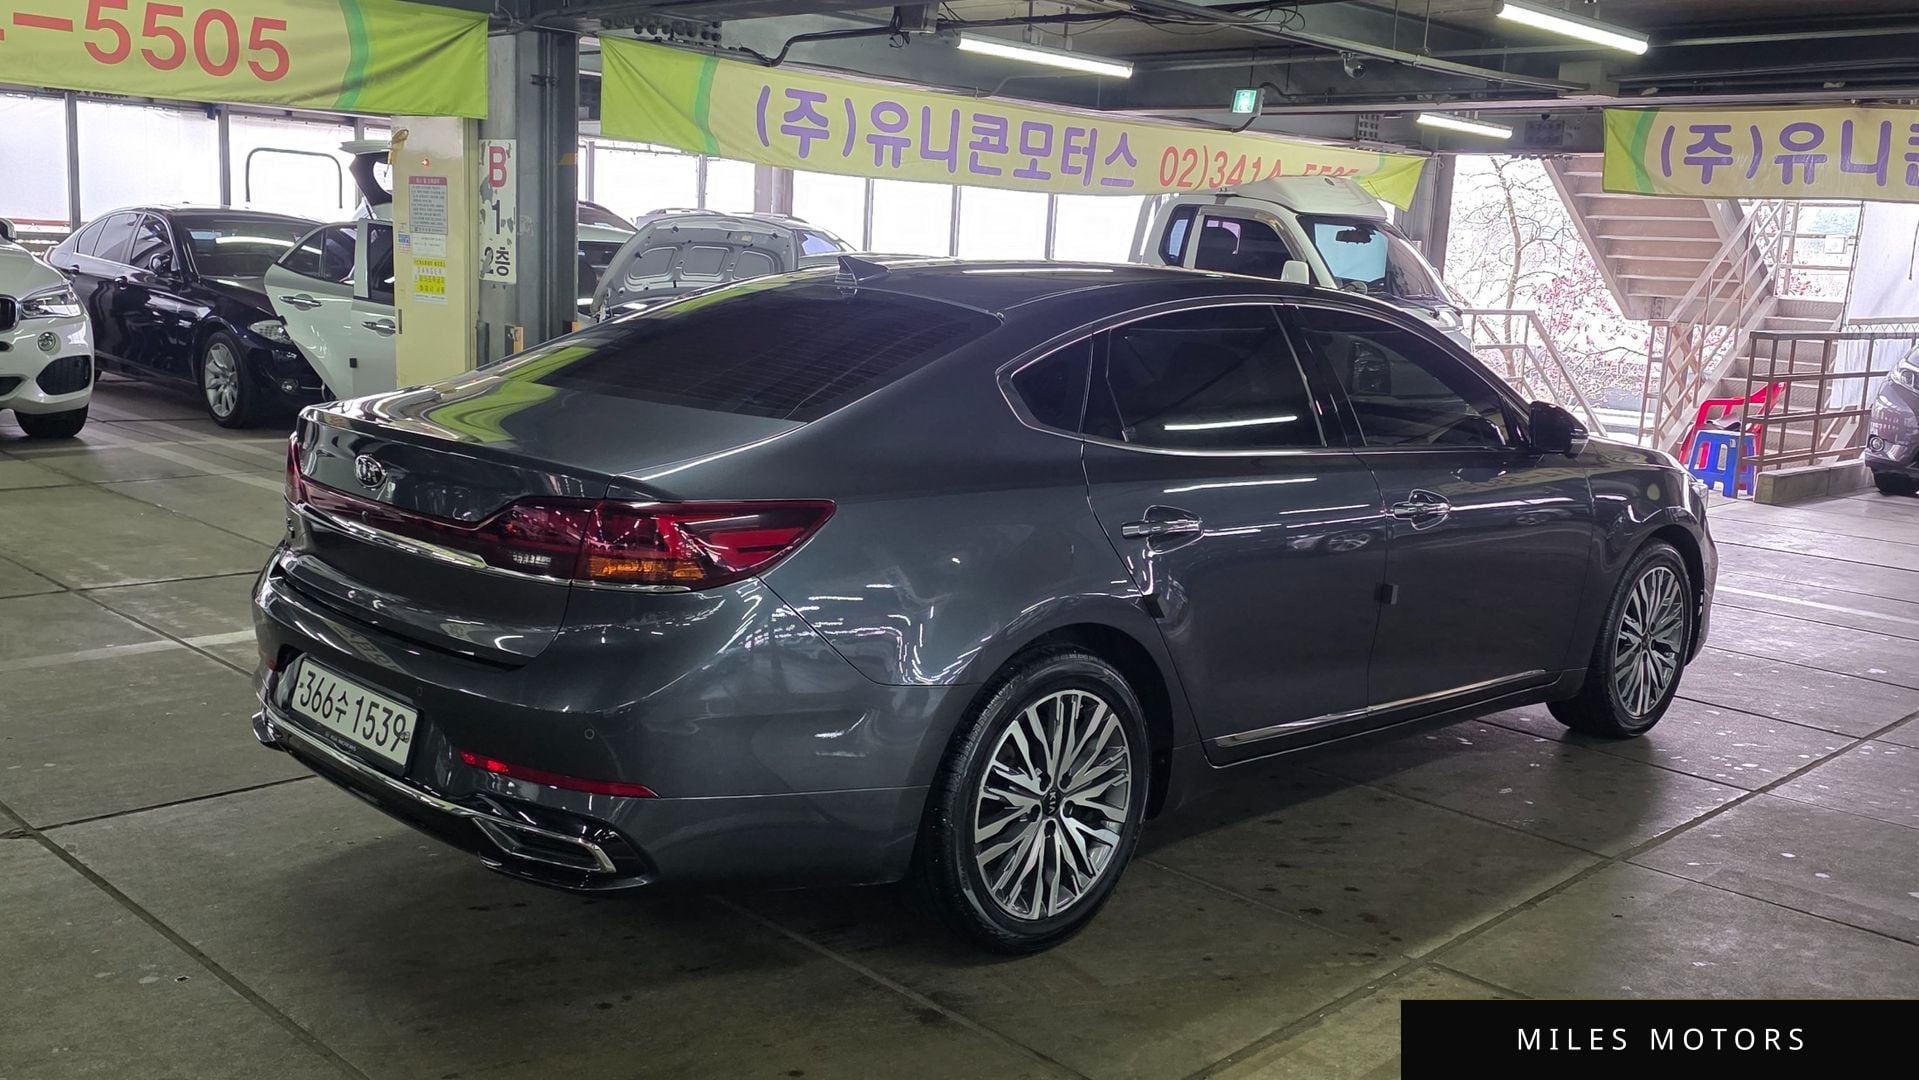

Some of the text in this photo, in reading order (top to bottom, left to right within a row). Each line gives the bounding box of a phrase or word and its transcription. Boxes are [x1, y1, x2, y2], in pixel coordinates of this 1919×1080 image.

[0, 0, 290, 81] -5505
[489, 146, 507, 188] B
[755, 84, 1138, 188] (주)유니콘모터스
[492, 200, 500, 234] 1
[300, 670, 406, 752] 366수 1539
